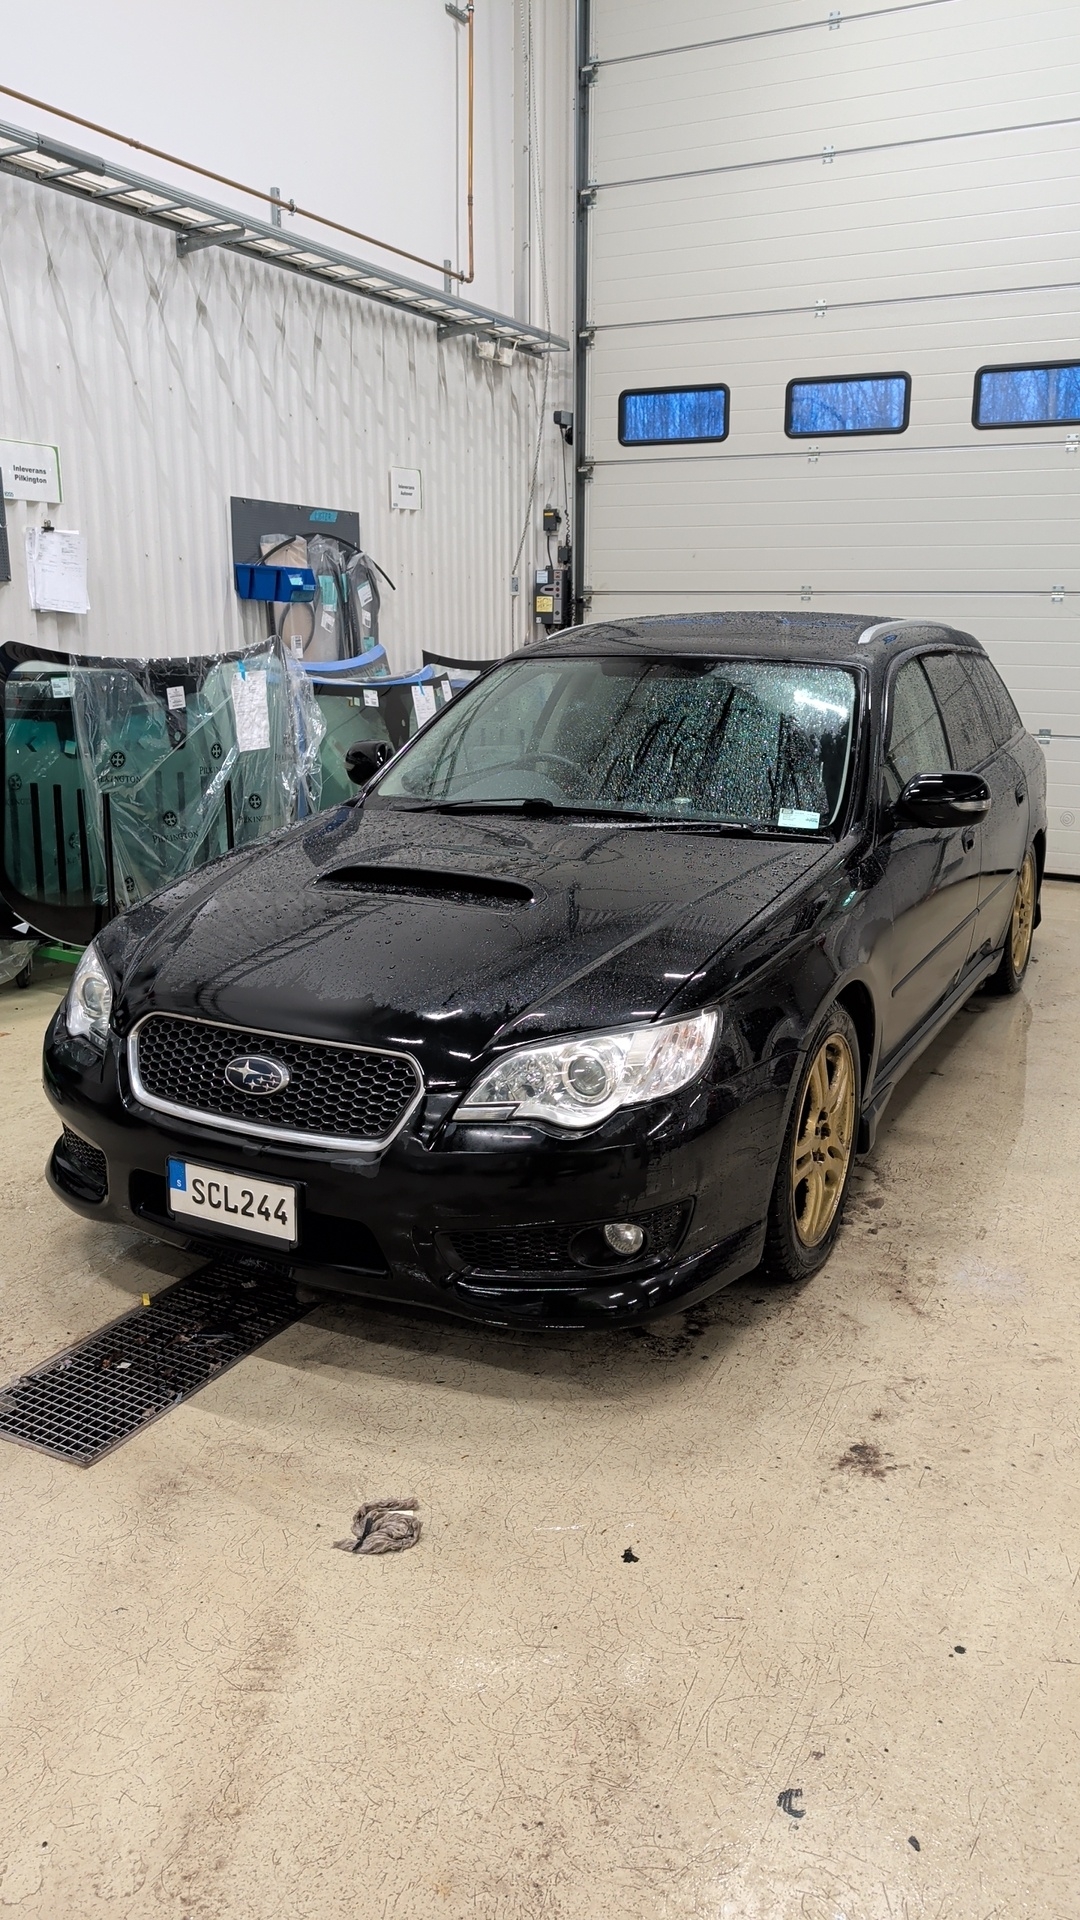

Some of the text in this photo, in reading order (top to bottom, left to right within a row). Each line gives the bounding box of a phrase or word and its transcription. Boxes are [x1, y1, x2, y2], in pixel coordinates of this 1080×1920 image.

[13, 465, 47, 474] Inleverans
[14, 474, 47, 484] Pilkington
[191, 1178, 288, 1225] SCL244
